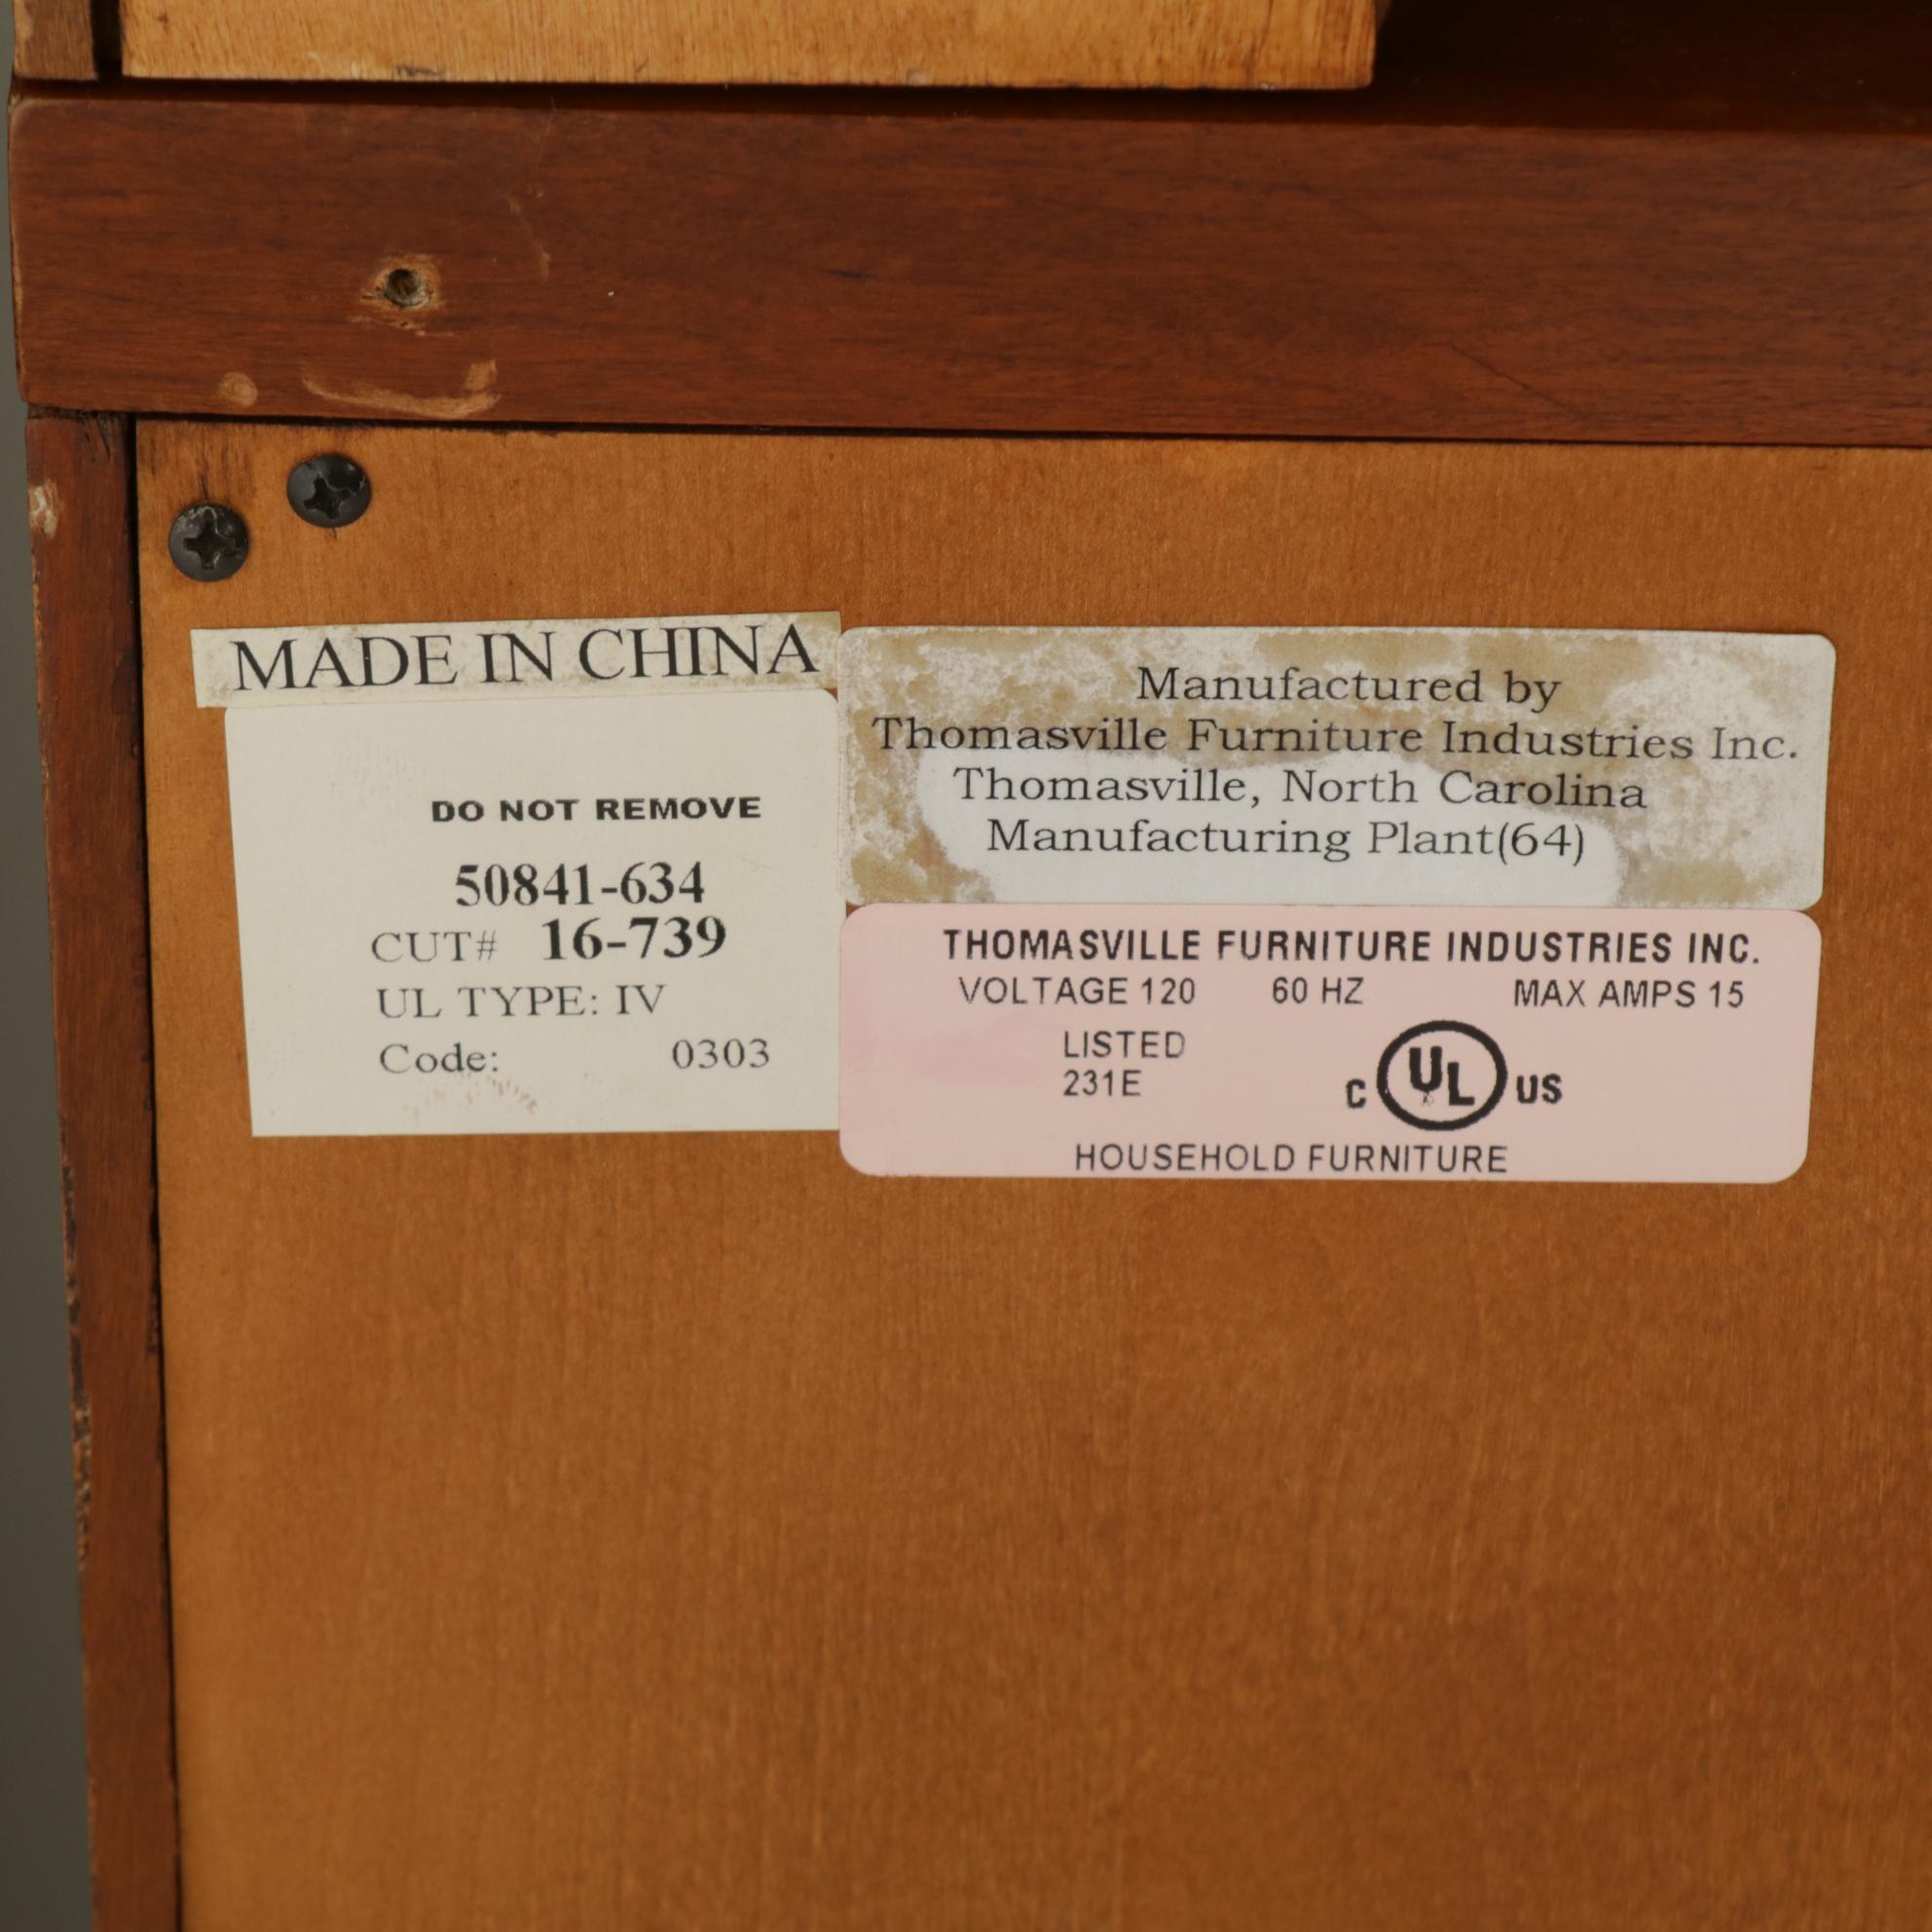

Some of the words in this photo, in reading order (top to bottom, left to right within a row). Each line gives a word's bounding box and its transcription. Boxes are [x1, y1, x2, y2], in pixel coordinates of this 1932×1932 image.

[230, 635, 457, 690] MADE
[477, 631, 555, 684] IN
[578, 622, 820, 680] CHINA
[1137, 667, 1481, 703] Manufactured
[1505, 670, 1561, 713] by
[872, 717, 1169, 751] Thomasville
[1188, 718, 1423, 753] Furniture
[1442, 721, 1693, 759] Industries
[1711, 726, 1798, 760] Inc.
[953, 766, 1260, 808] Thomasville,
[1282, 769, 1418, 803] North
[1440, 769, 1648, 808] Carolina
[431, 799, 484, 822] DO
[501, 799, 578, 822] NOT
[596, 797, 762, 820] REMOVE
[986, 819, 1352, 863] Manufacturing
[1368, 821, 1584, 866] Plant(64)
[455, 861, 706, 907] 50841-634
[371, 930, 499, 963] CUT#
[541, 915, 726, 960] 16-739
[943, 930, 1200, 961] THOMASVILLE
[1217, 931, 1430, 961] FURNITURE
[1447, 932, 1672, 963] INDUSTRIES
[1689, 932, 1760, 964] INC.
[376, 986, 441, 1019] UL
[458, 985, 599, 1017] TYPE:
[615, 983, 666, 1015] IV
[959, 977, 1128, 1004] VOLTAGE
[1140, 977, 1196, 1004] 120
[1272, 977, 1308, 1004] 60
[1321, 977, 1364, 1004] HZ
[1514, 979, 1585, 1007] MAX
[1599, 980, 1695, 1008] AMPS
[1708, 981, 1744, 1009] 15
[380, 1042, 500, 1073] Code:
[672, 1038, 769, 1069] 0303
[1063, 1031, 1185, 1059] LISTED
[1063, 1069, 1141, 1096] 231E
[1408, 1045, 1475, 1106] UL
[1516, 1074, 1563, 1104] US
[1075, 1143, 1294, 1171] HOUSEHOLD
[1309, 1145, 1508, 1173] FURNITURE
